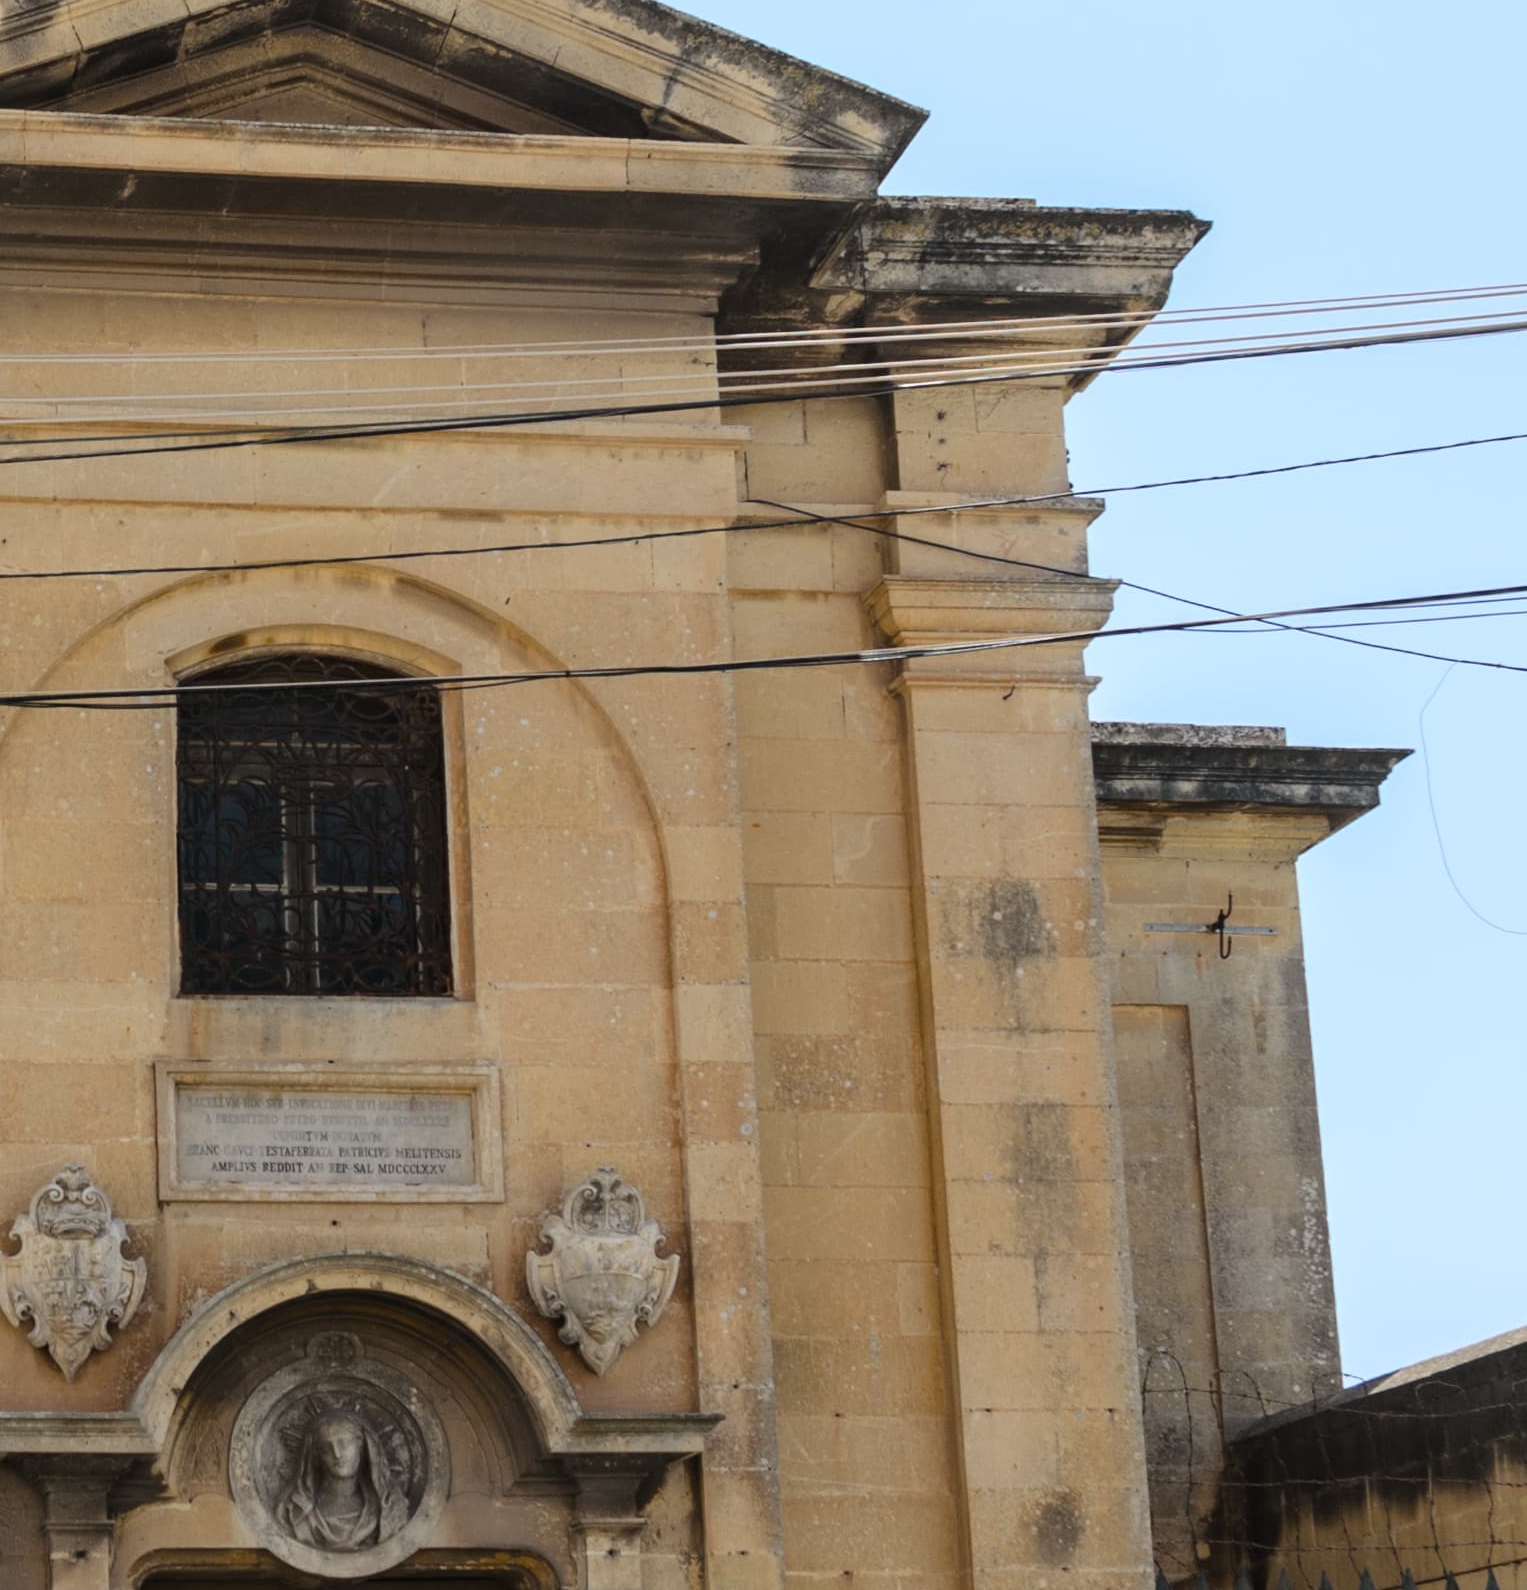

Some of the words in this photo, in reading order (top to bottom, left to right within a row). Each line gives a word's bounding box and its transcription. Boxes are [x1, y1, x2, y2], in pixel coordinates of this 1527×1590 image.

[338, 1146, 392, 1159] PATRICIVS
[395, 1147, 462, 1160] MELITENSIS
[211, 1162, 257, 1173] AMPLIVS
[262, 1162, 304, 1174] REDDIT
[353, 1163, 374, 1175] SAL
